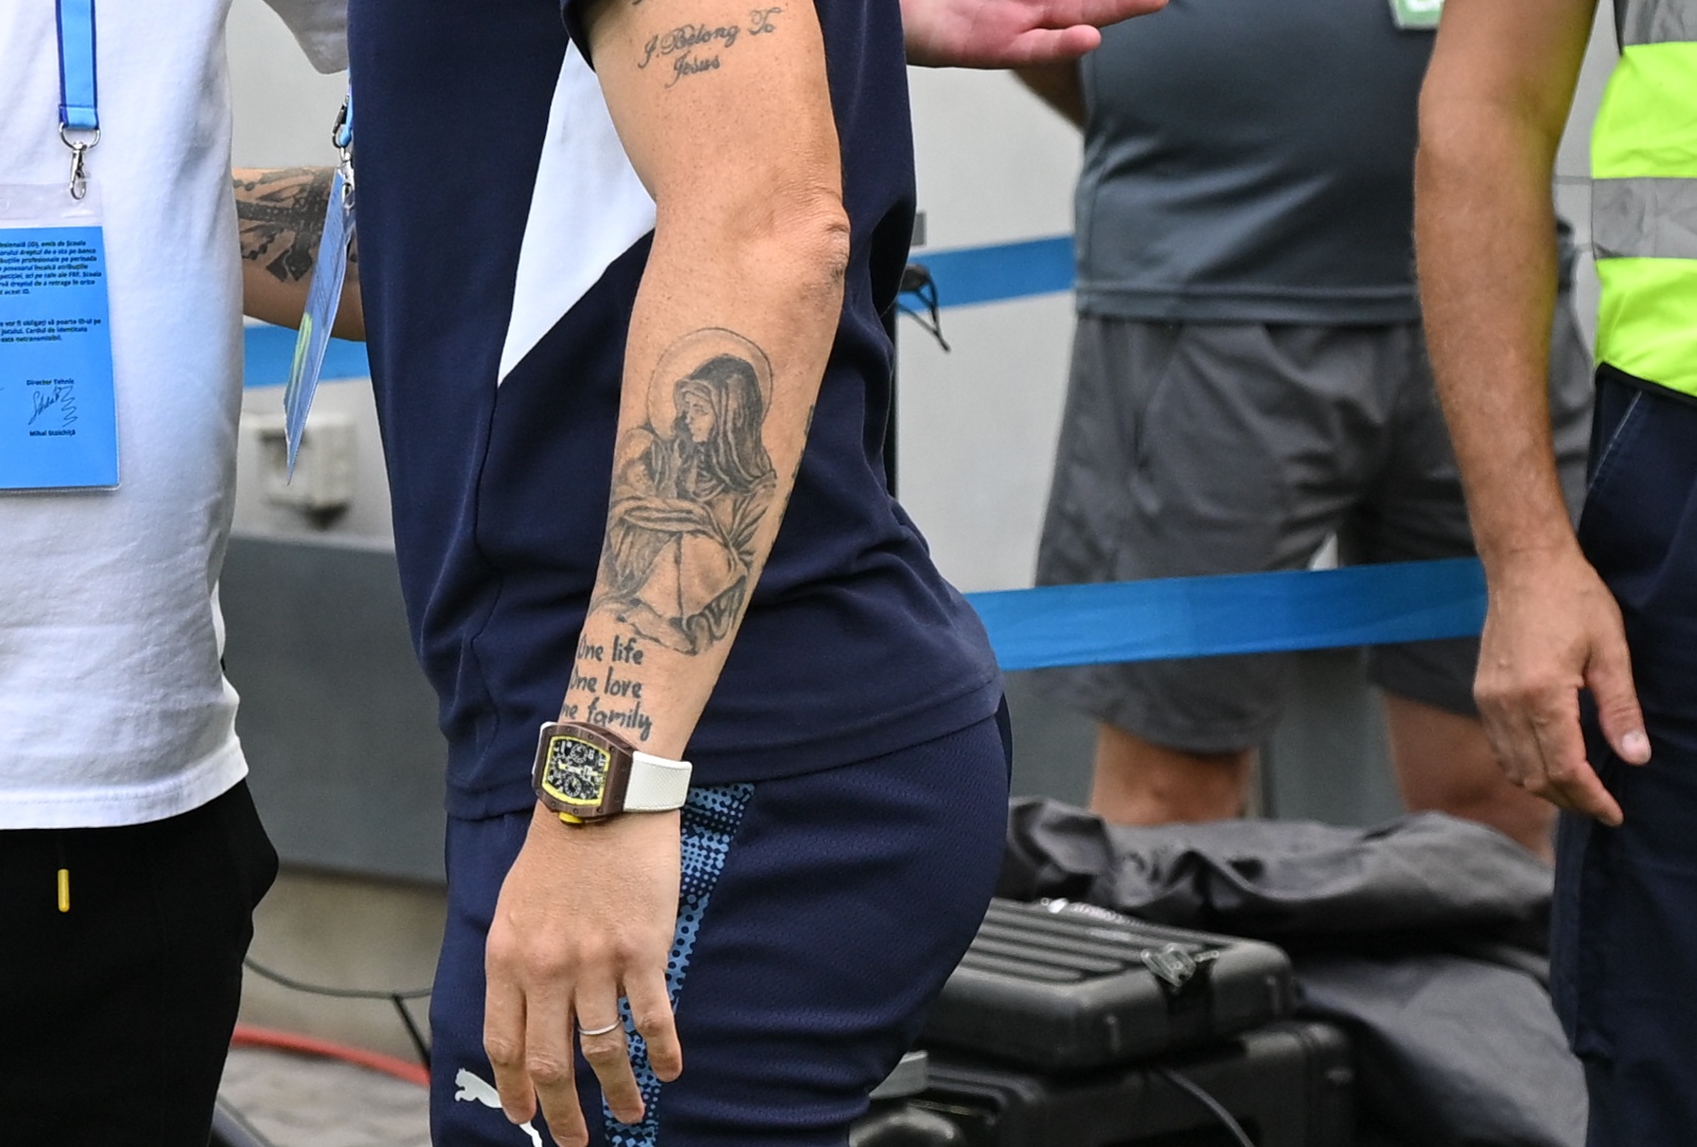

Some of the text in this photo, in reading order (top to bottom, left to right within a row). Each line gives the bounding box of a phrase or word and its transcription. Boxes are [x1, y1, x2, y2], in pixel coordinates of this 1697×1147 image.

[664, 50, 721, 89] Jesus
[578, 635, 643, 665] One life
[604, 666, 642, 699] love
[588, 696, 653, 742] family
